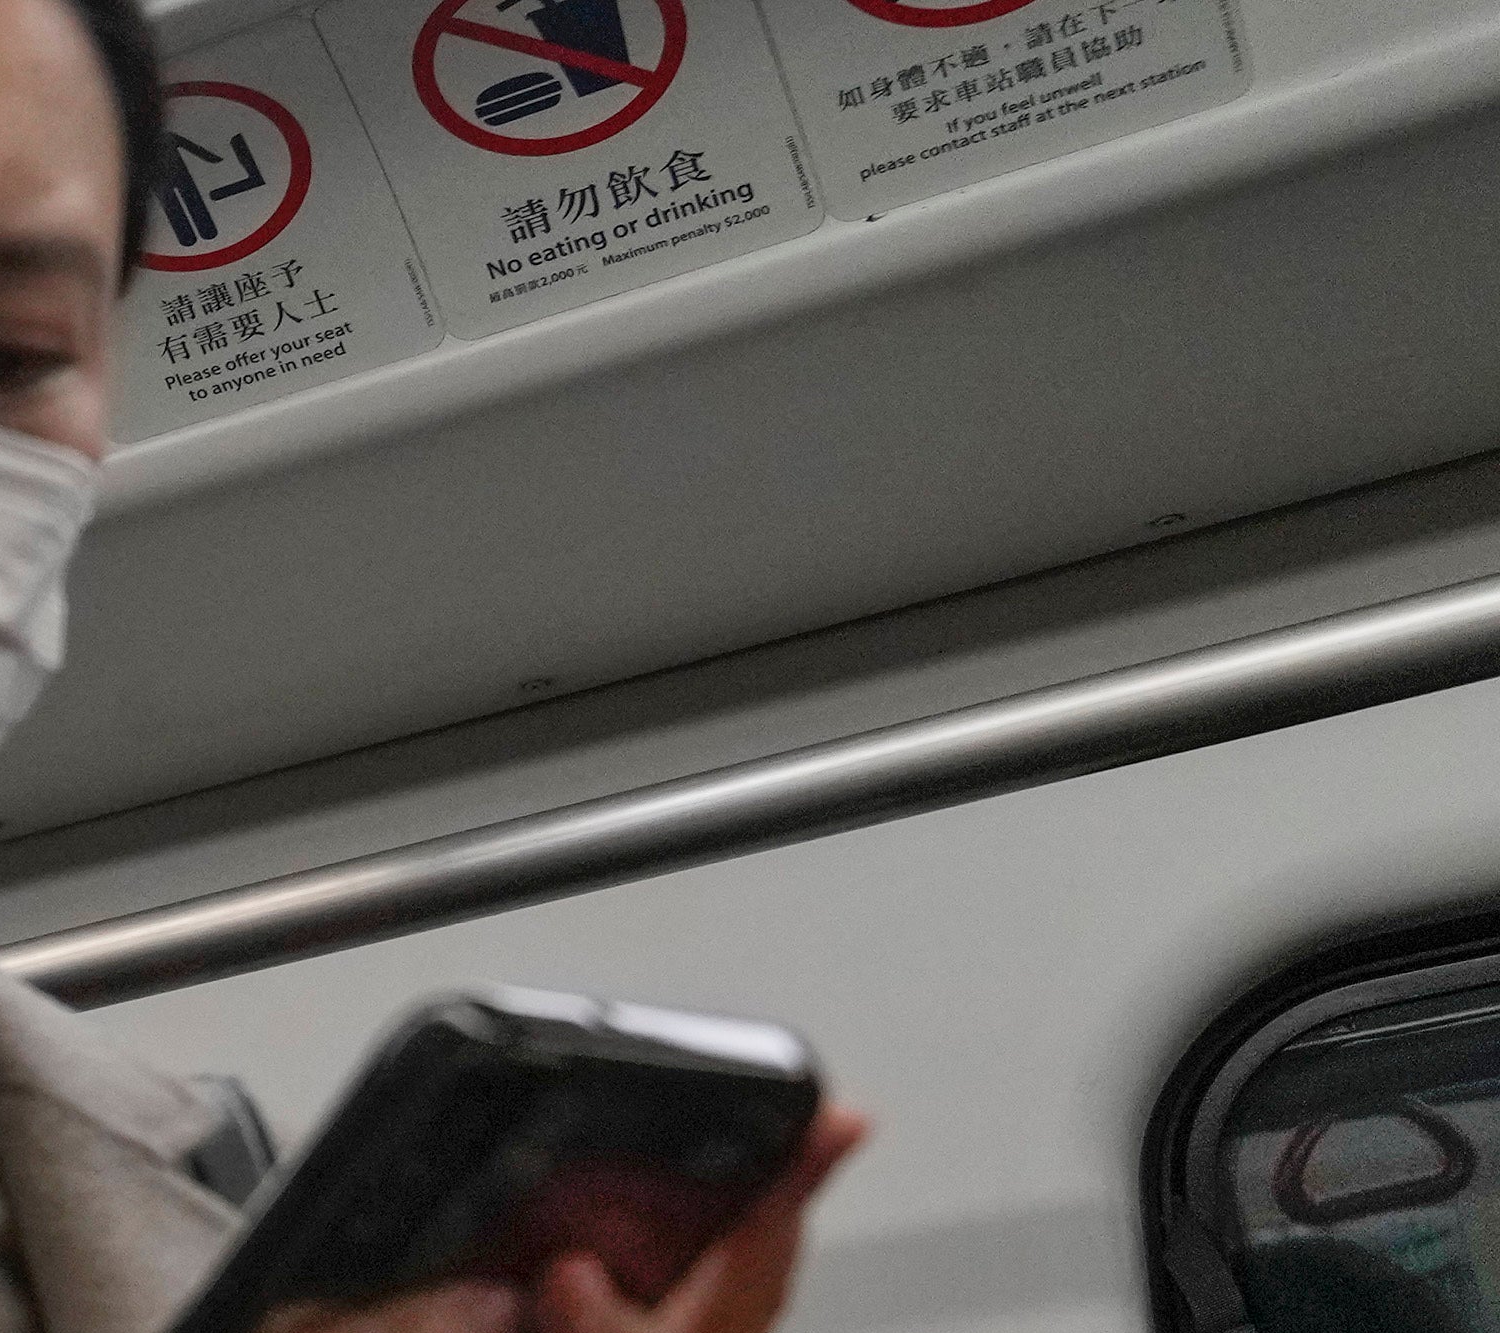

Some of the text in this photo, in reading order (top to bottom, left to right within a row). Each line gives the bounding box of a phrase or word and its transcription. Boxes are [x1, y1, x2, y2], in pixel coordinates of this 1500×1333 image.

[892, 25, 1143, 125] 要求車站職員協助
[945, 72, 1103, 134] If you feel unwell
[860, 59, 1206, 183] please contact staff at the next station
[486, 181, 755, 281] No eating or drinking
[500, 148, 712, 244] 請勿飲食
[602, 204, 771, 267] Maximum penalty $2,000
[157, 288, 340, 365] 有需要人士
[161, 258, 303, 327] 請讓座予
[165, 321, 354, 390] Please offer your seat
[188, 342, 347, 402] to anyone in need
